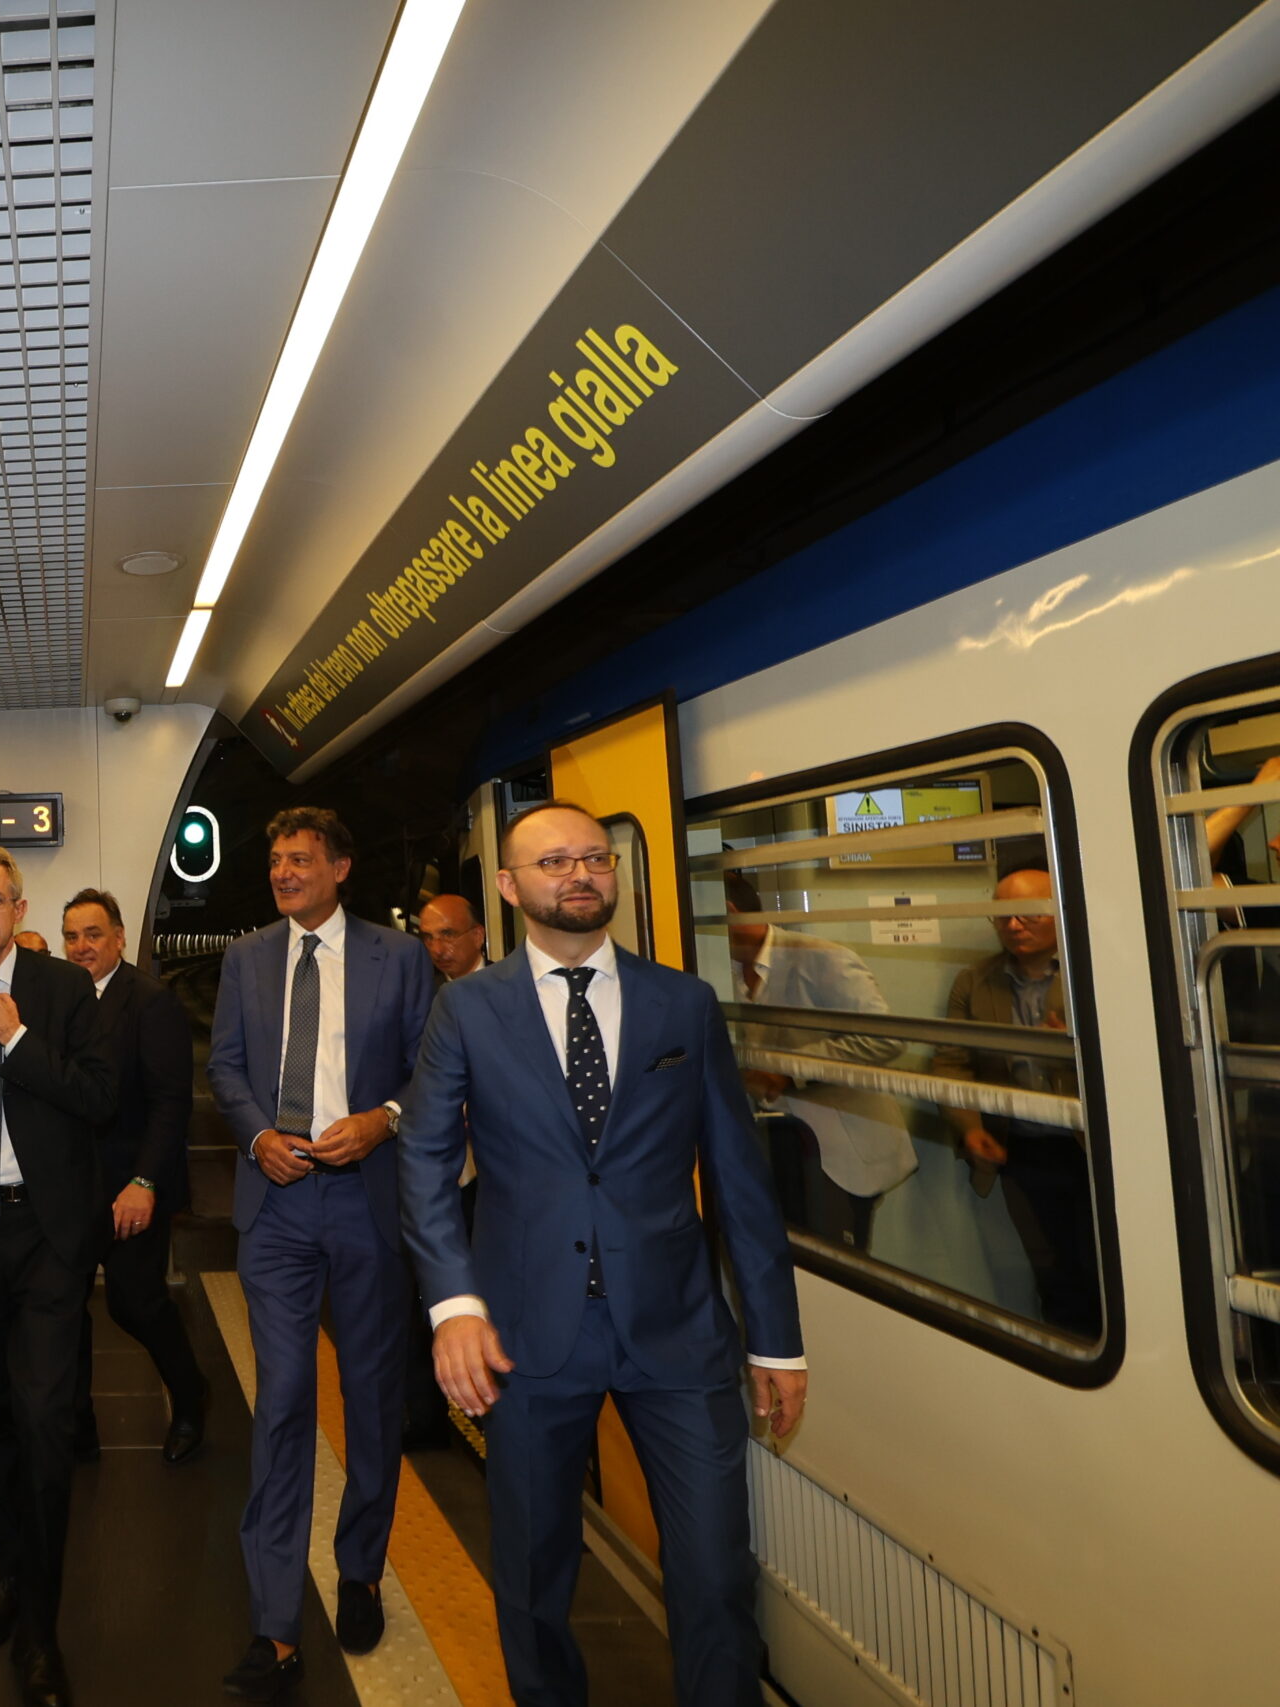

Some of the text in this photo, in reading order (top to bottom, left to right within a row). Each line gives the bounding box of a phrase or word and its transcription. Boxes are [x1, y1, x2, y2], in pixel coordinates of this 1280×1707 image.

[275, 324, 679, 732] In attesa del treno non oltrepassare la linea gialla
